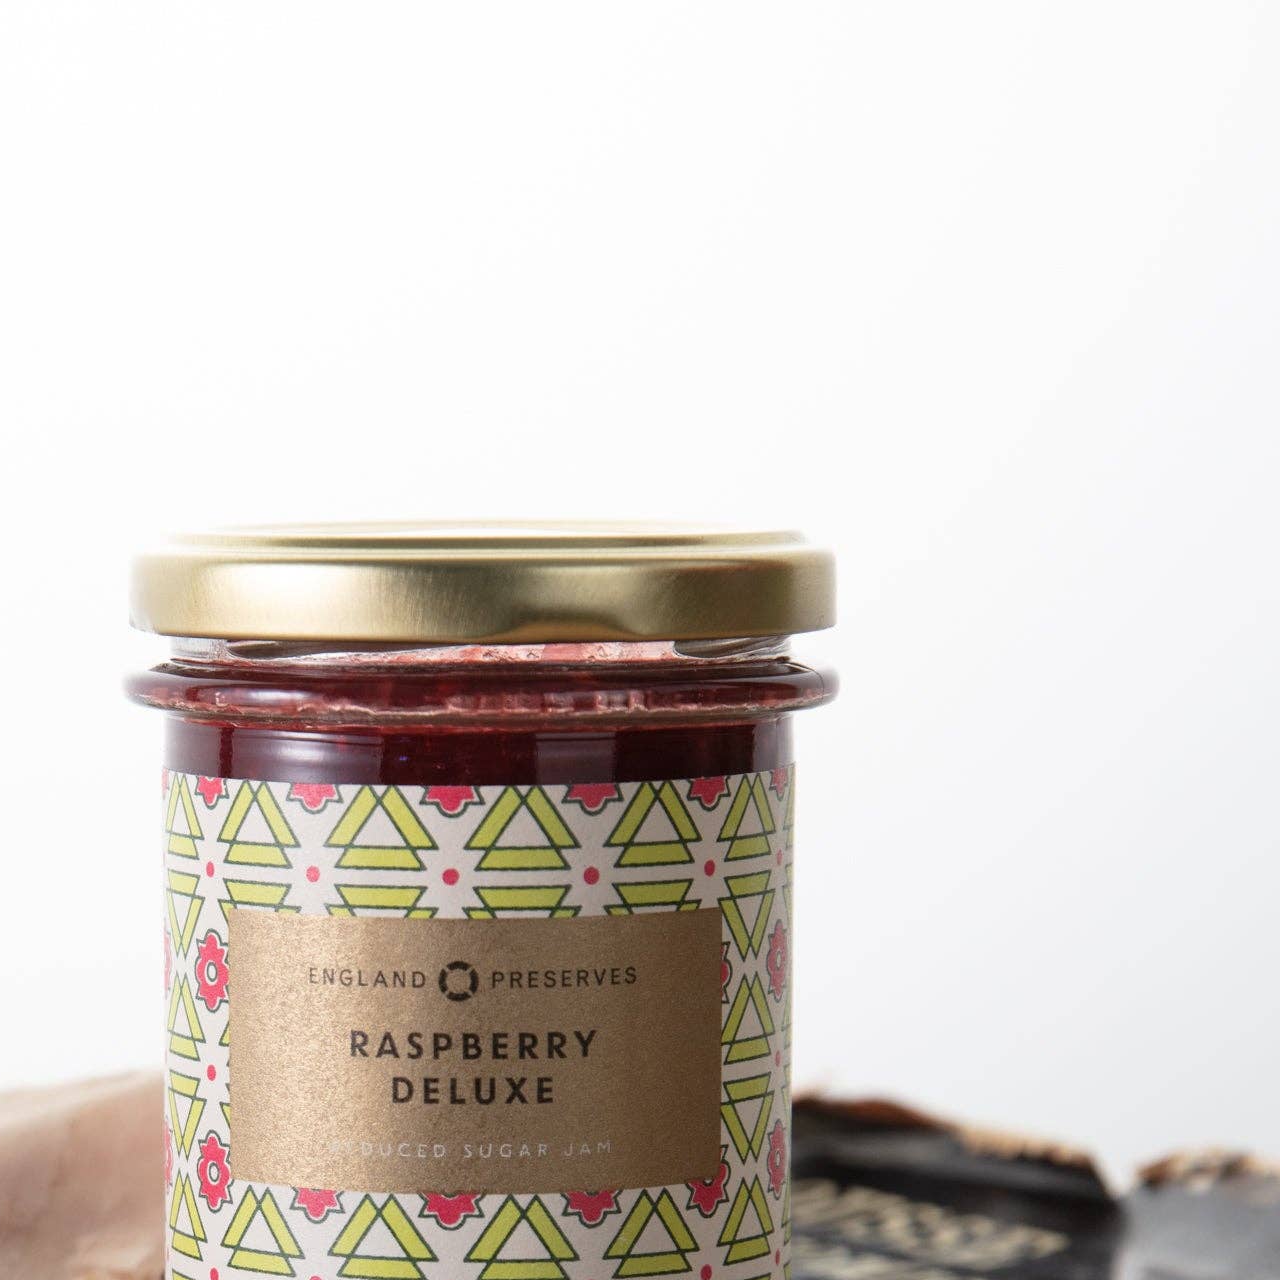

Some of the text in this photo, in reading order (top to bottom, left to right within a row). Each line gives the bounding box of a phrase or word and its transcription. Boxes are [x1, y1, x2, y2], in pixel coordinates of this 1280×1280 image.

[309, 966, 638, 989] ENGLAND PRESERVES
[349, 1029, 597, 1060] RASPBERRY
[391, 1076, 555, 1105] DELUXE
[463, 1143, 548, 1159] SUGAR
[563, 1140, 612, 1157] JAM
